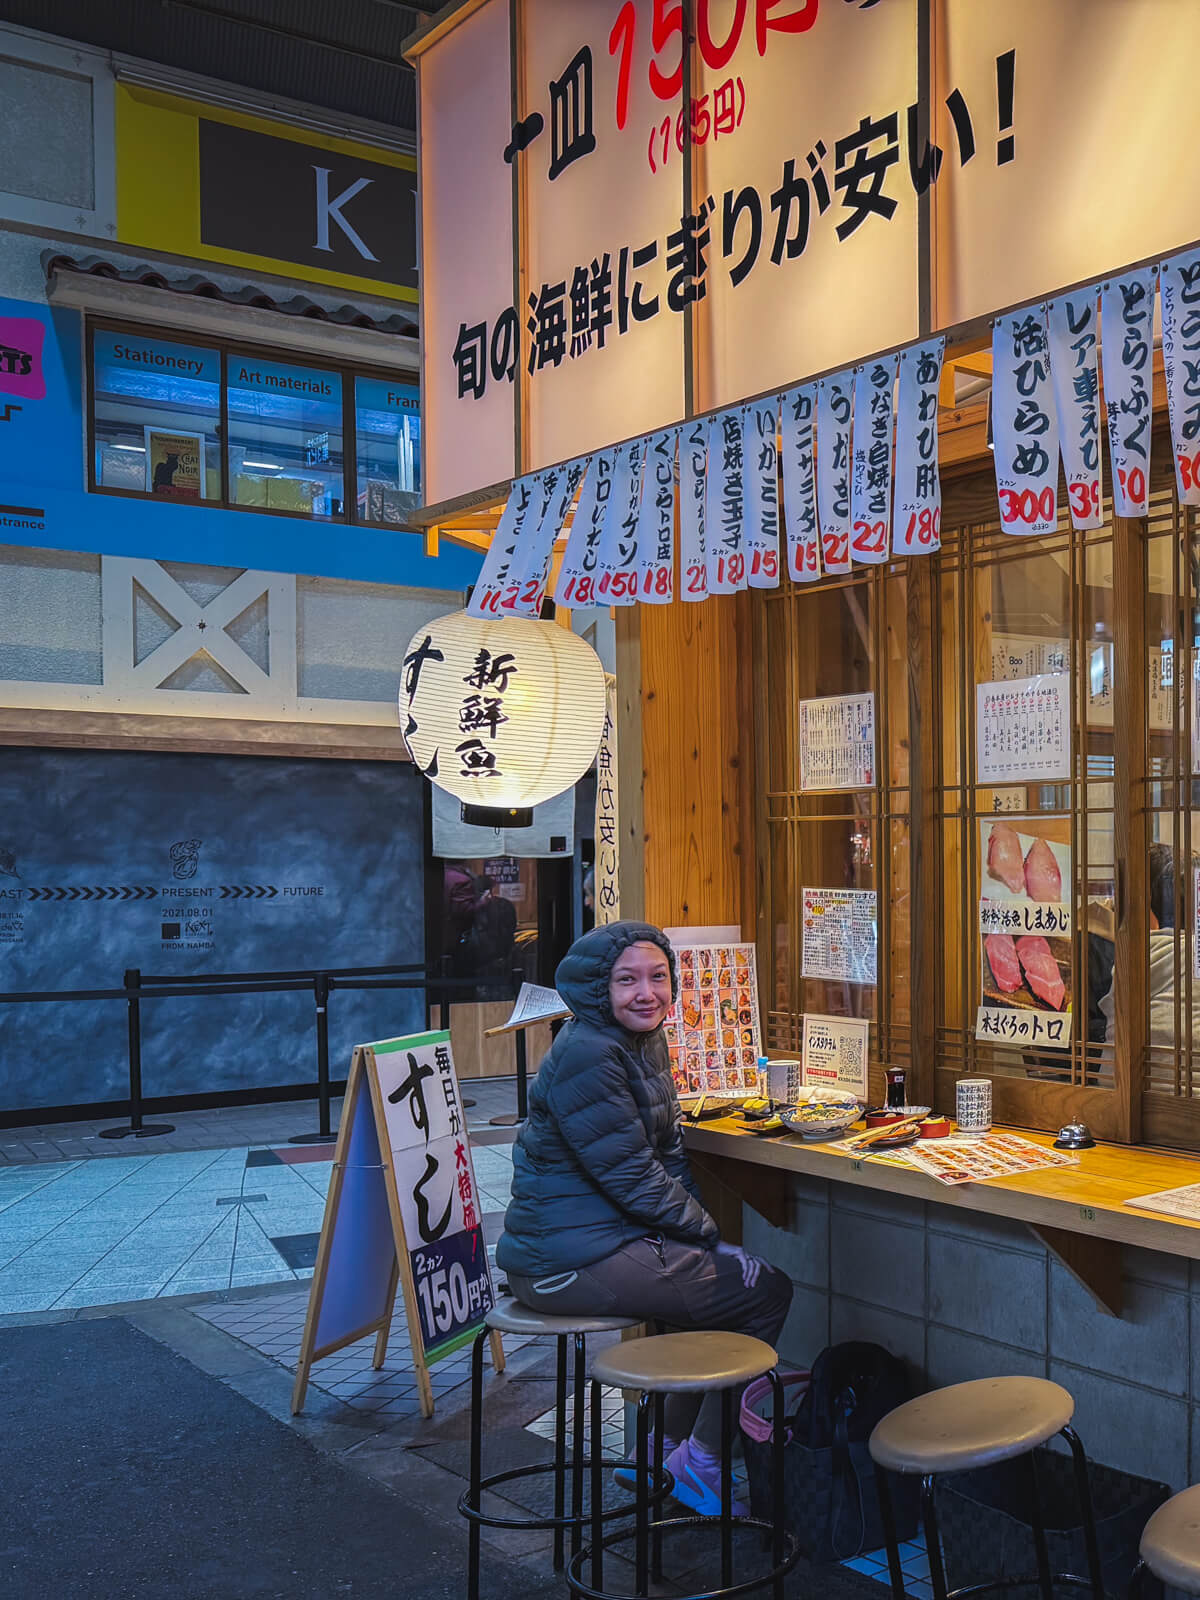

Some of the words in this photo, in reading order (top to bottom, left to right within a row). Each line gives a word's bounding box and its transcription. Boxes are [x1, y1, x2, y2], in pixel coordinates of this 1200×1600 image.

[503, 45, 596, 181] 一皿
[113, 345, 204, 375] Stationery
[239, 367, 262, 384] Art
[265, 373, 332, 396] materials
[1011, 315, 1050, 477] 活ひらめ
[867, 364, 890, 514] うなぎ白焼き
[721, 415, 743, 549] 店焼き玉子
[998, 486, 1055, 523] 300
[403, 635, 445, 778] すし
[455, 648, 518, 778] 新鮮魚
[162, 888, 215, 897] PRESENT
[283, 886, 324, 896] FUTURE
[162, 908, 214, 918] 2021.08.01
[981, 1007, 1064, 1041] 本まぐろのトロ
[388, 1052, 455, 1244] すし
[1082, 1208, 1093, 1220] 13
